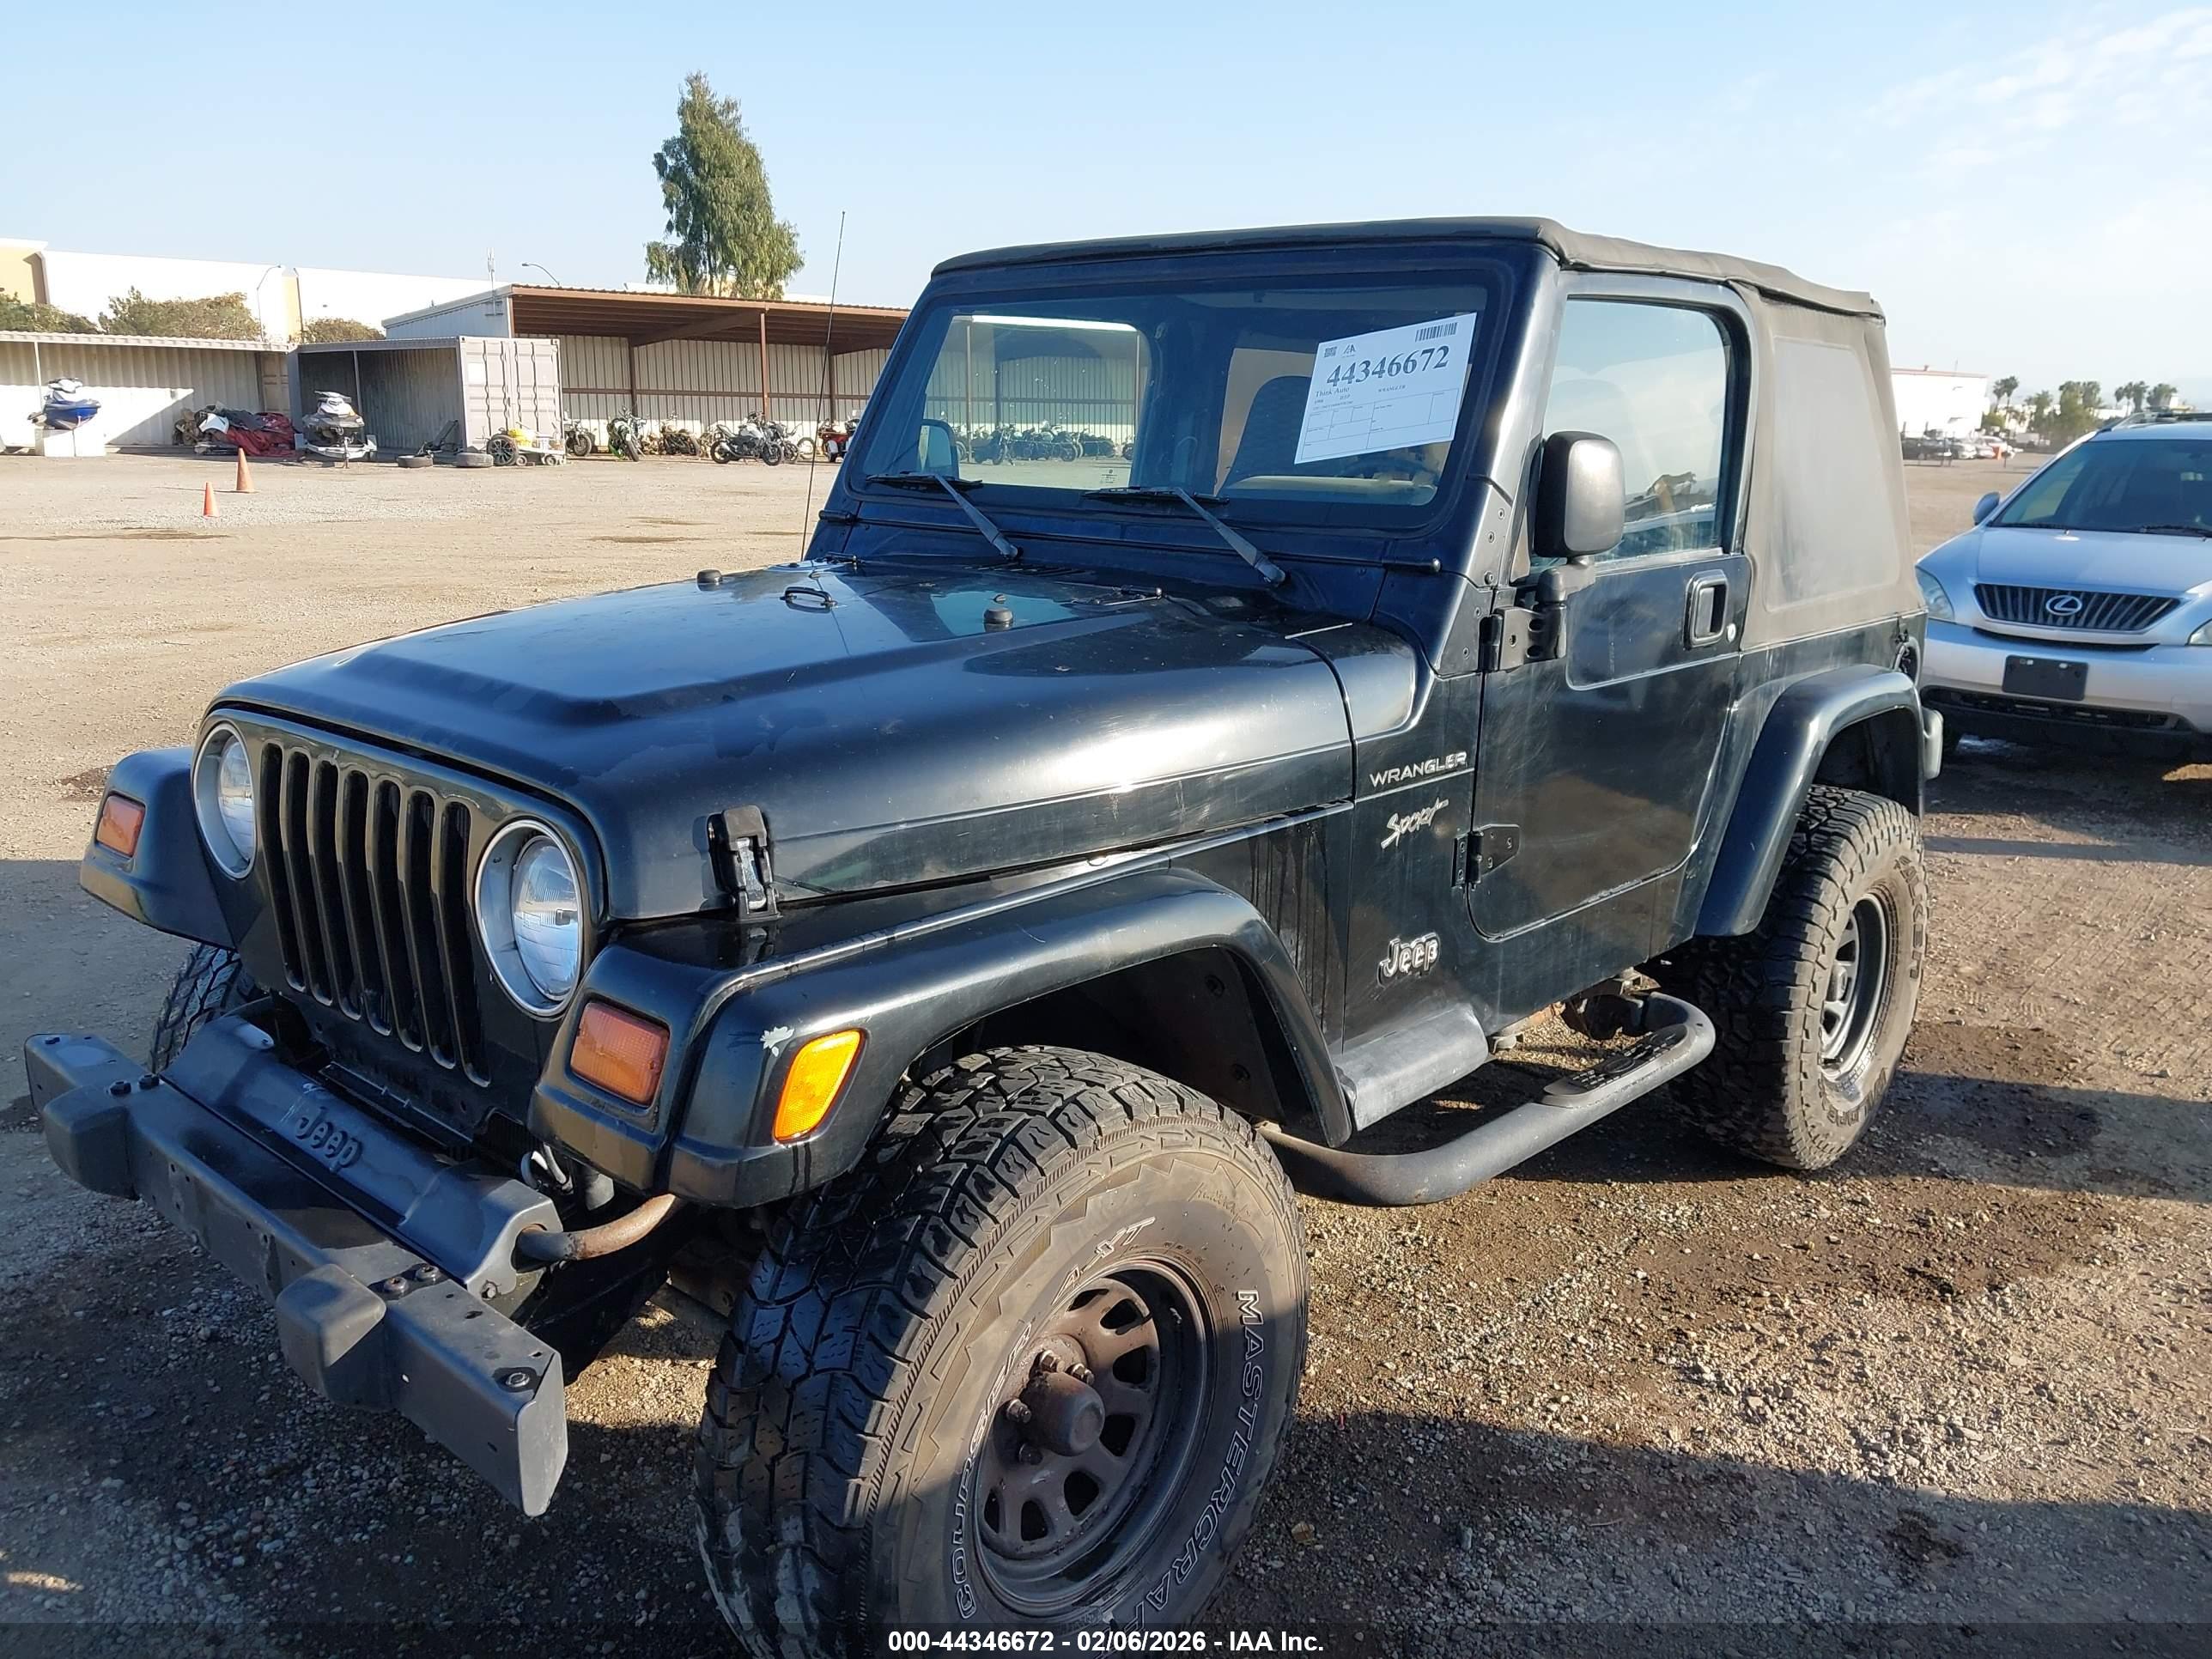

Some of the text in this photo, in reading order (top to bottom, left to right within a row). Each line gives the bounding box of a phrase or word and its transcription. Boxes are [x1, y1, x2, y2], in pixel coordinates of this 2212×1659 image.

[1327, 345, 1449, 386] 44346672
[1370, 751, 1468, 787] WRANGLER
[1381, 798, 1449, 849] Sport
[1377, 933, 1440, 982] Jeep
[296, 1106, 363, 1172] Jeep
[951, 1323, 1031, 1619] COURSER
